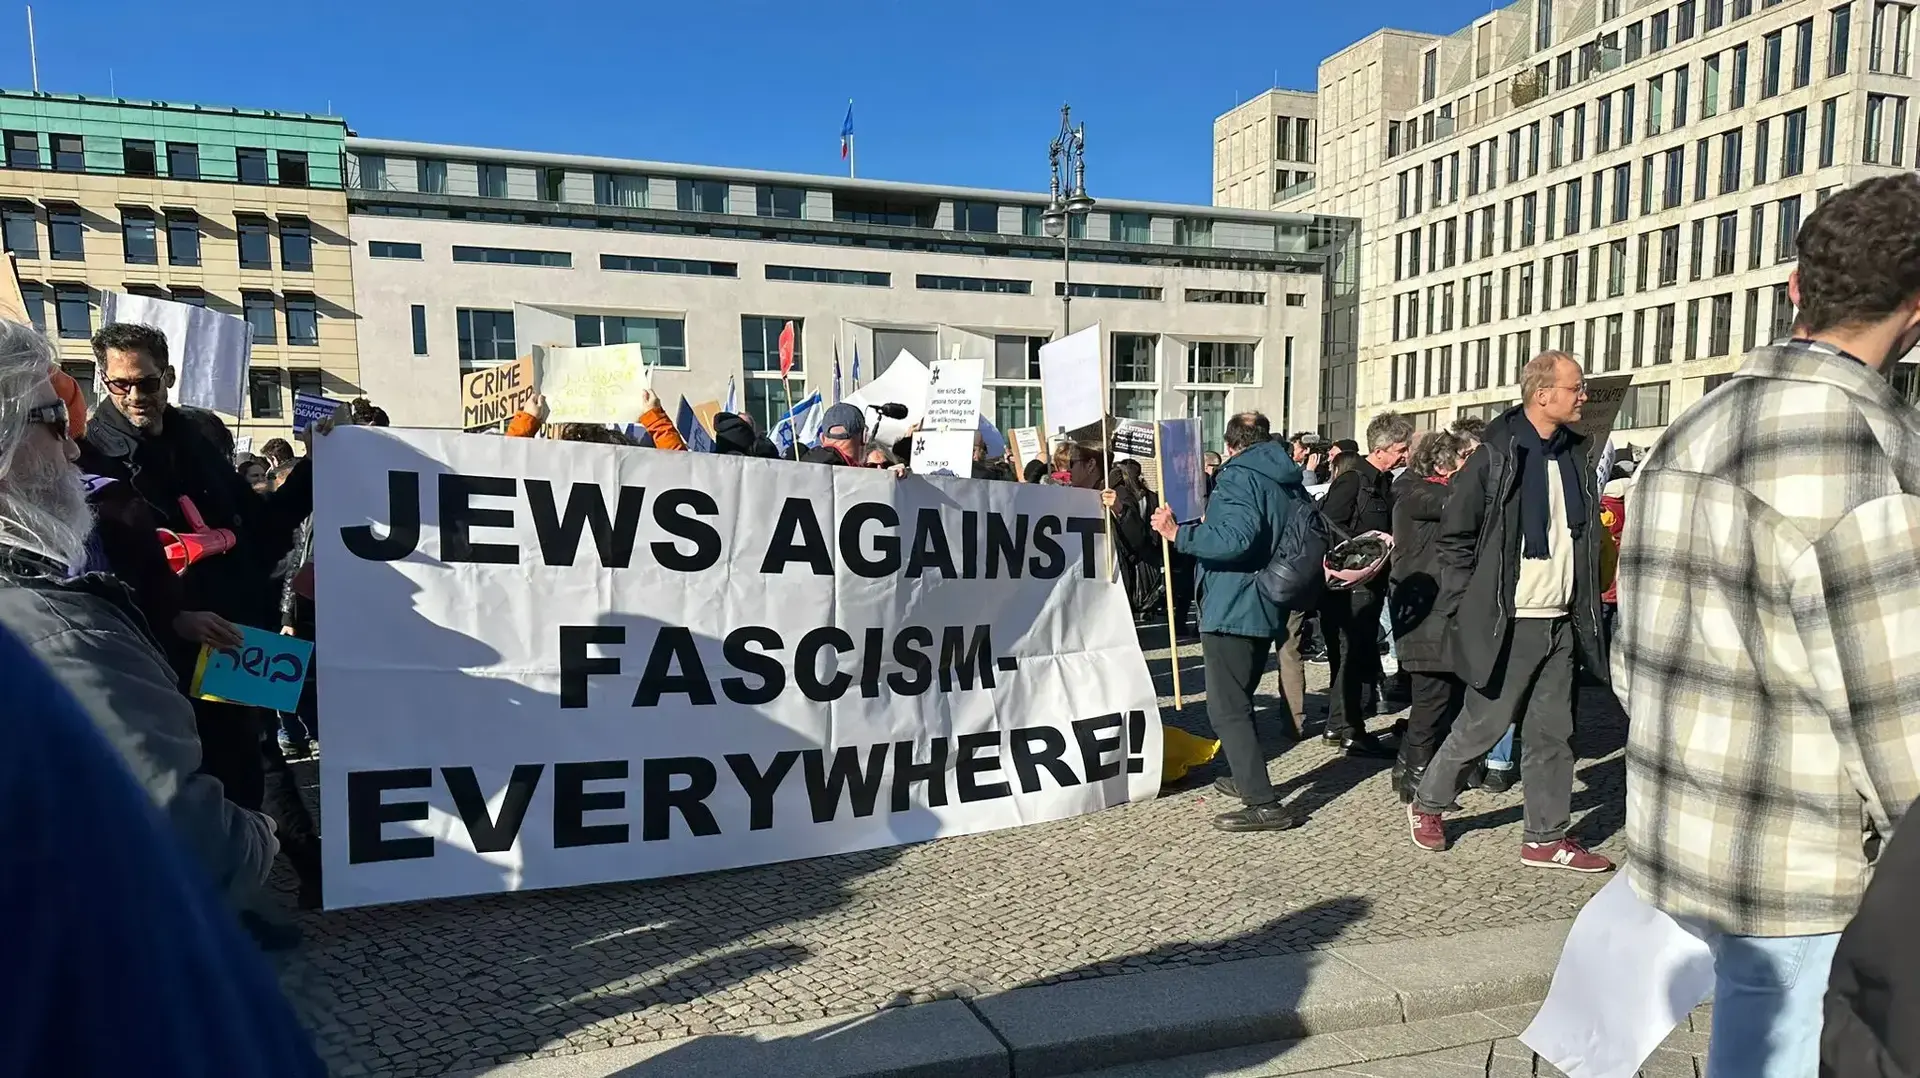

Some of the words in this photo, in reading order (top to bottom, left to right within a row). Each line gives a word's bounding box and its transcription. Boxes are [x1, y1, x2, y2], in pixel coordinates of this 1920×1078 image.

[469, 363, 521, 400] CRIME
[340, 470, 722, 572] JEWS
[759, 497, 1107, 580] AGAINST
[559, 625, 1019, 709] FASCISM-
[348, 709, 1146, 866] EVERYWHERE!
[1551, 849, 1576, 865] N
